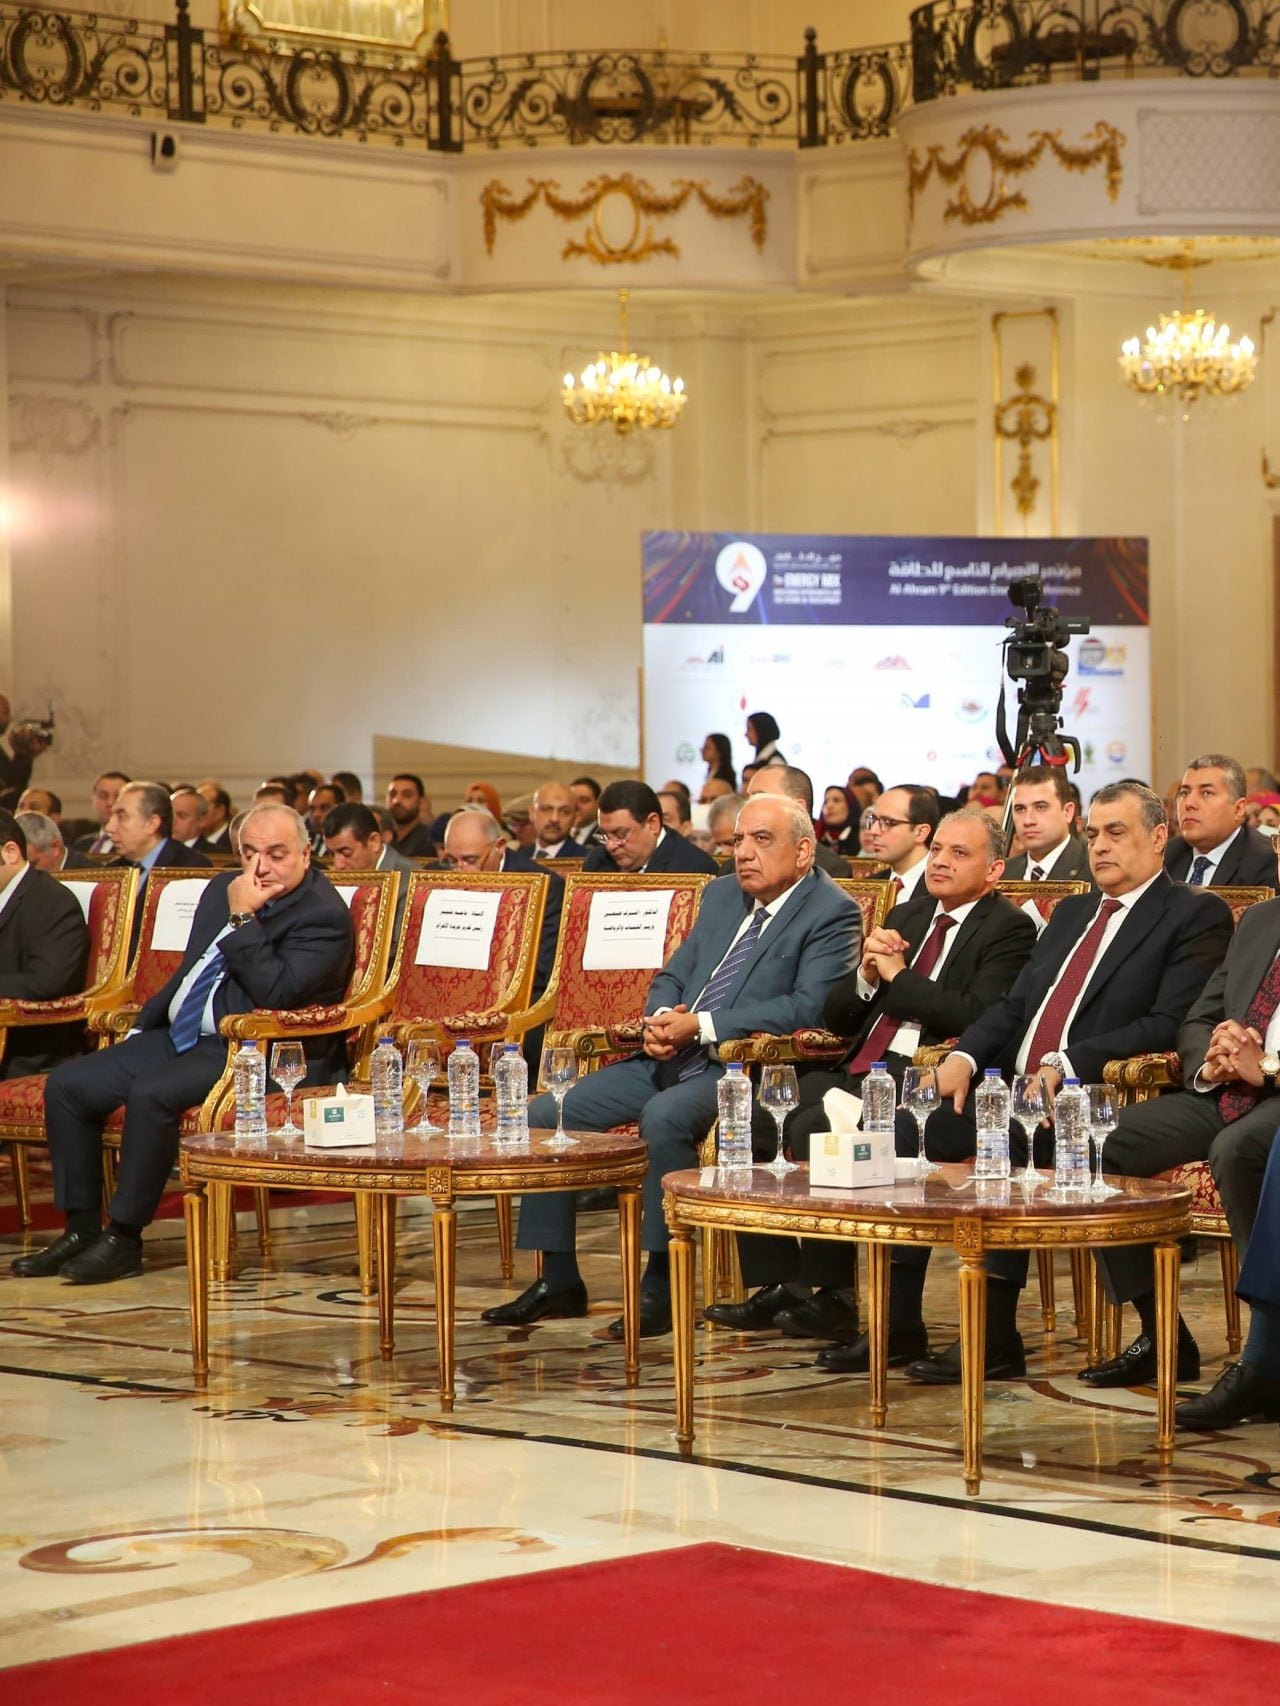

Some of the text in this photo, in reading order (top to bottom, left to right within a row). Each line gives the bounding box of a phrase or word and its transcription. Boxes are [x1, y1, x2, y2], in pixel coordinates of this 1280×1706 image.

[784, 572, 820, 588] ENERGY
[821, 572, 841, 588] MIX
[889, 582, 902, 596] Al
[902, 582, 937, 596] Ahram
[952, 582, 988, 596] Edition
